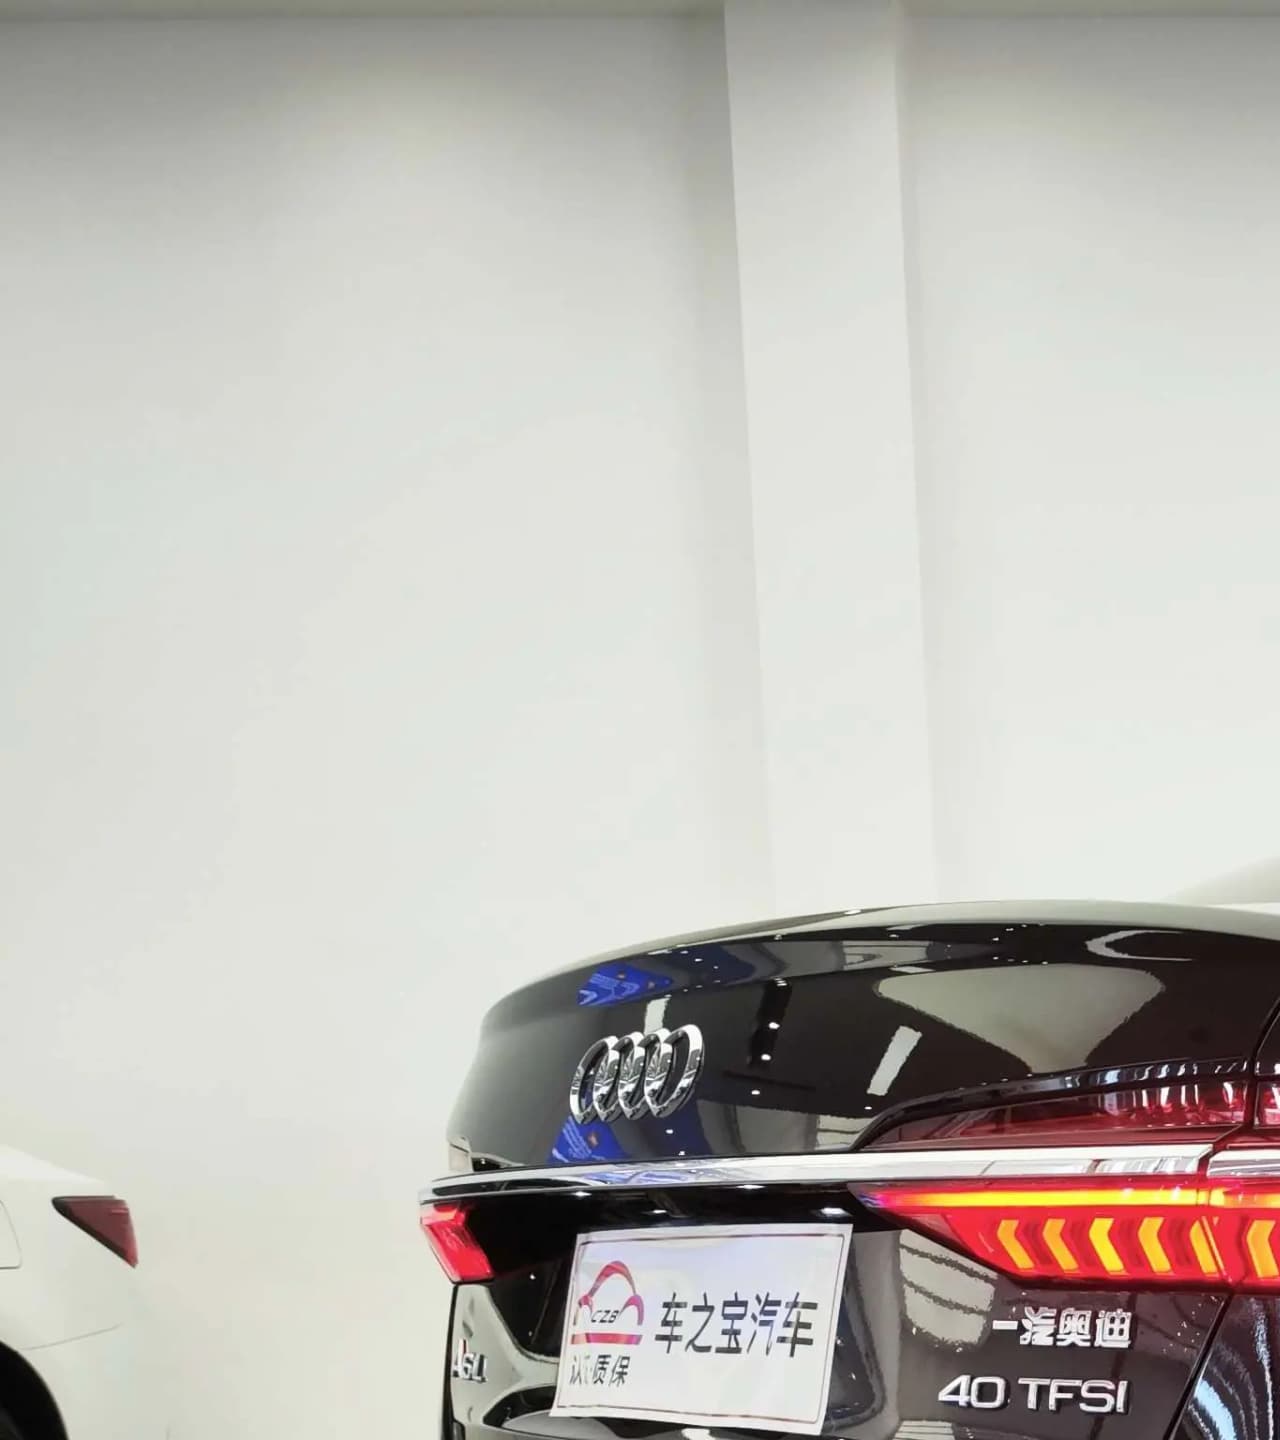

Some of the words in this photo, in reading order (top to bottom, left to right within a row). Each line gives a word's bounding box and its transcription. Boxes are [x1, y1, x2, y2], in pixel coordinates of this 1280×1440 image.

[590, 1309, 620, 1324] CZB
[654, 1291, 819, 1358] 车之宝汽车
[992, 1306, 1133, 1349] 一汽奥迪
[569, 1353, 631, 1388] 认质保
[937, 1374, 1007, 1410] 40
[1017, 1377, 1129, 1414] TFSI
